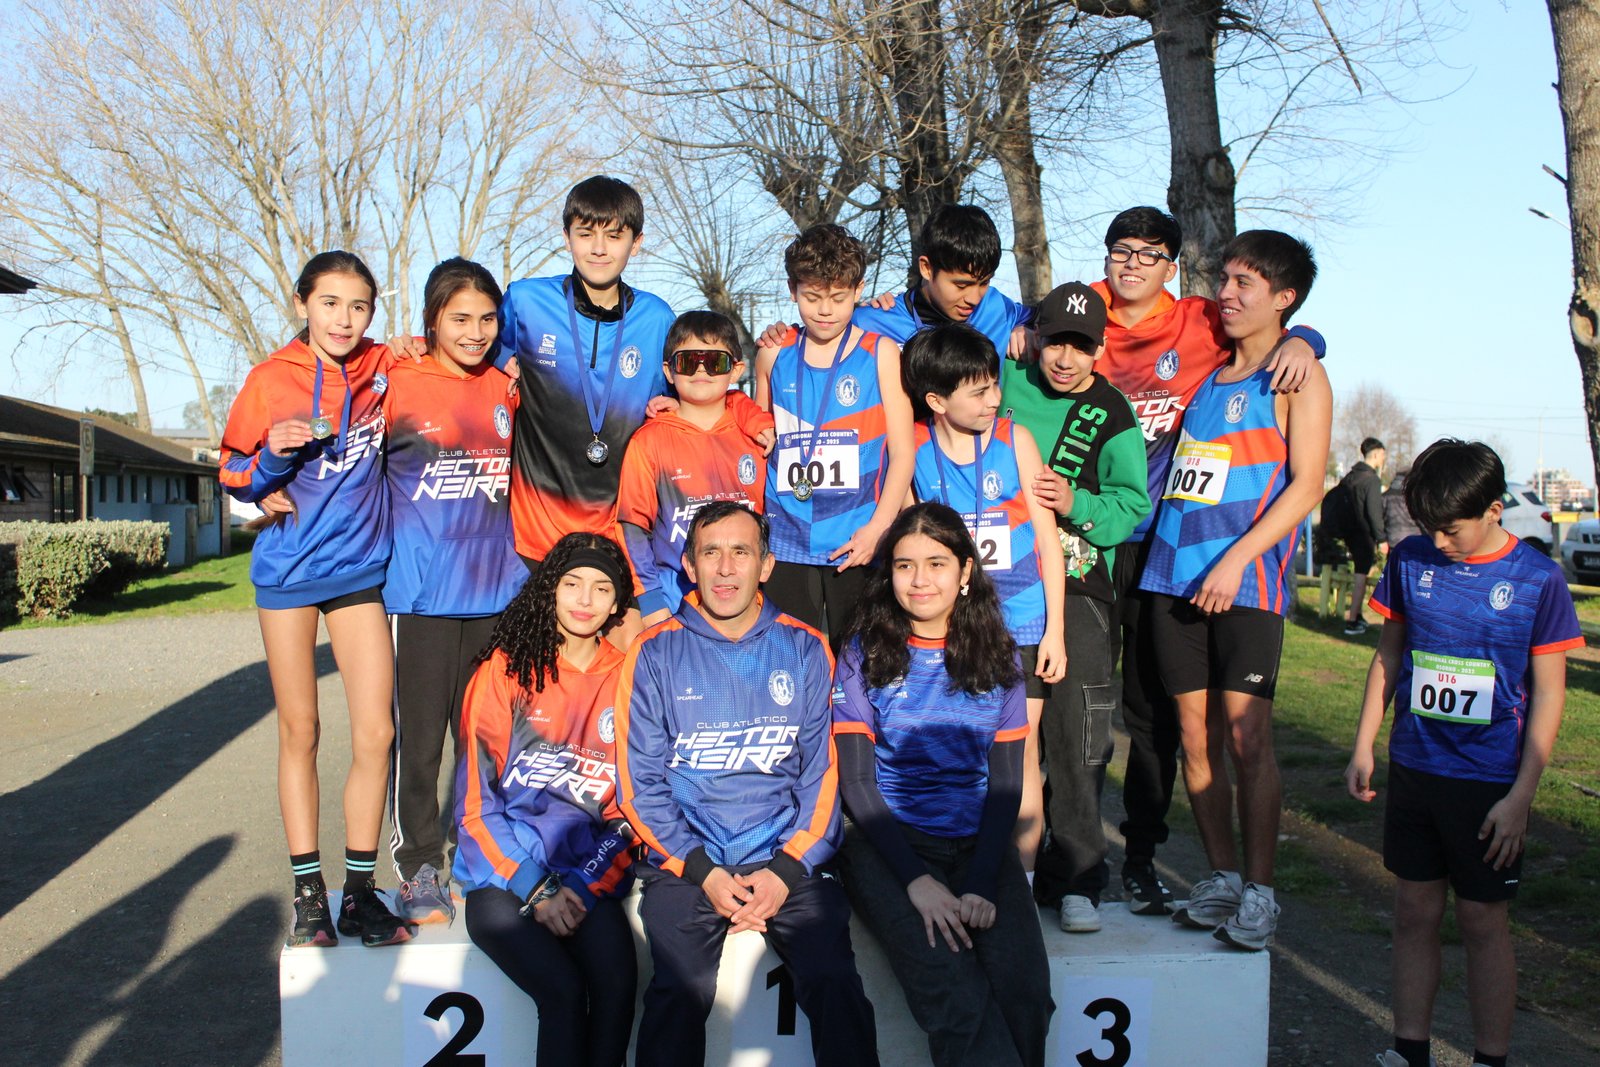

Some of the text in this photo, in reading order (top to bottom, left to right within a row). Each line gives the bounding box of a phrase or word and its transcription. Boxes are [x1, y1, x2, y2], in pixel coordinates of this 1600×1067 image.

[1066, 293, 1088, 315] NY
[1125, 390, 1169, 399] TLETICO
[465, 448, 507, 456] ATLETICO
[1052, 404, 1108, 490] LTICS
[788, 460, 845, 488] 001
[1172, 468, 1214, 495] 007
[411, 474, 510, 503] NEIRA
[687, 494, 713, 503] CLUB
[981, 511, 1004, 519] COUNTRY
[1465, 660, 1491, 668] COUNTRY
[1438, 673, 1457, 684] U16
[1420, 684, 1478, 716] 007
[697, 716, 788, 729] CLUB ATLETICO
[673, 725, 800, 750] HECTOR
[567, 743, 606, 760] ATLETICO
[669, 745, 794, 774] NEIRA
[512, 750, 616, 783] HECTOR
[502, 766, 612, 804] NEIRA
[766, 962, 797, 1035] 1
[423, 992, 486, 1067] 2
[1075, 997, 1131, 1067] 3
